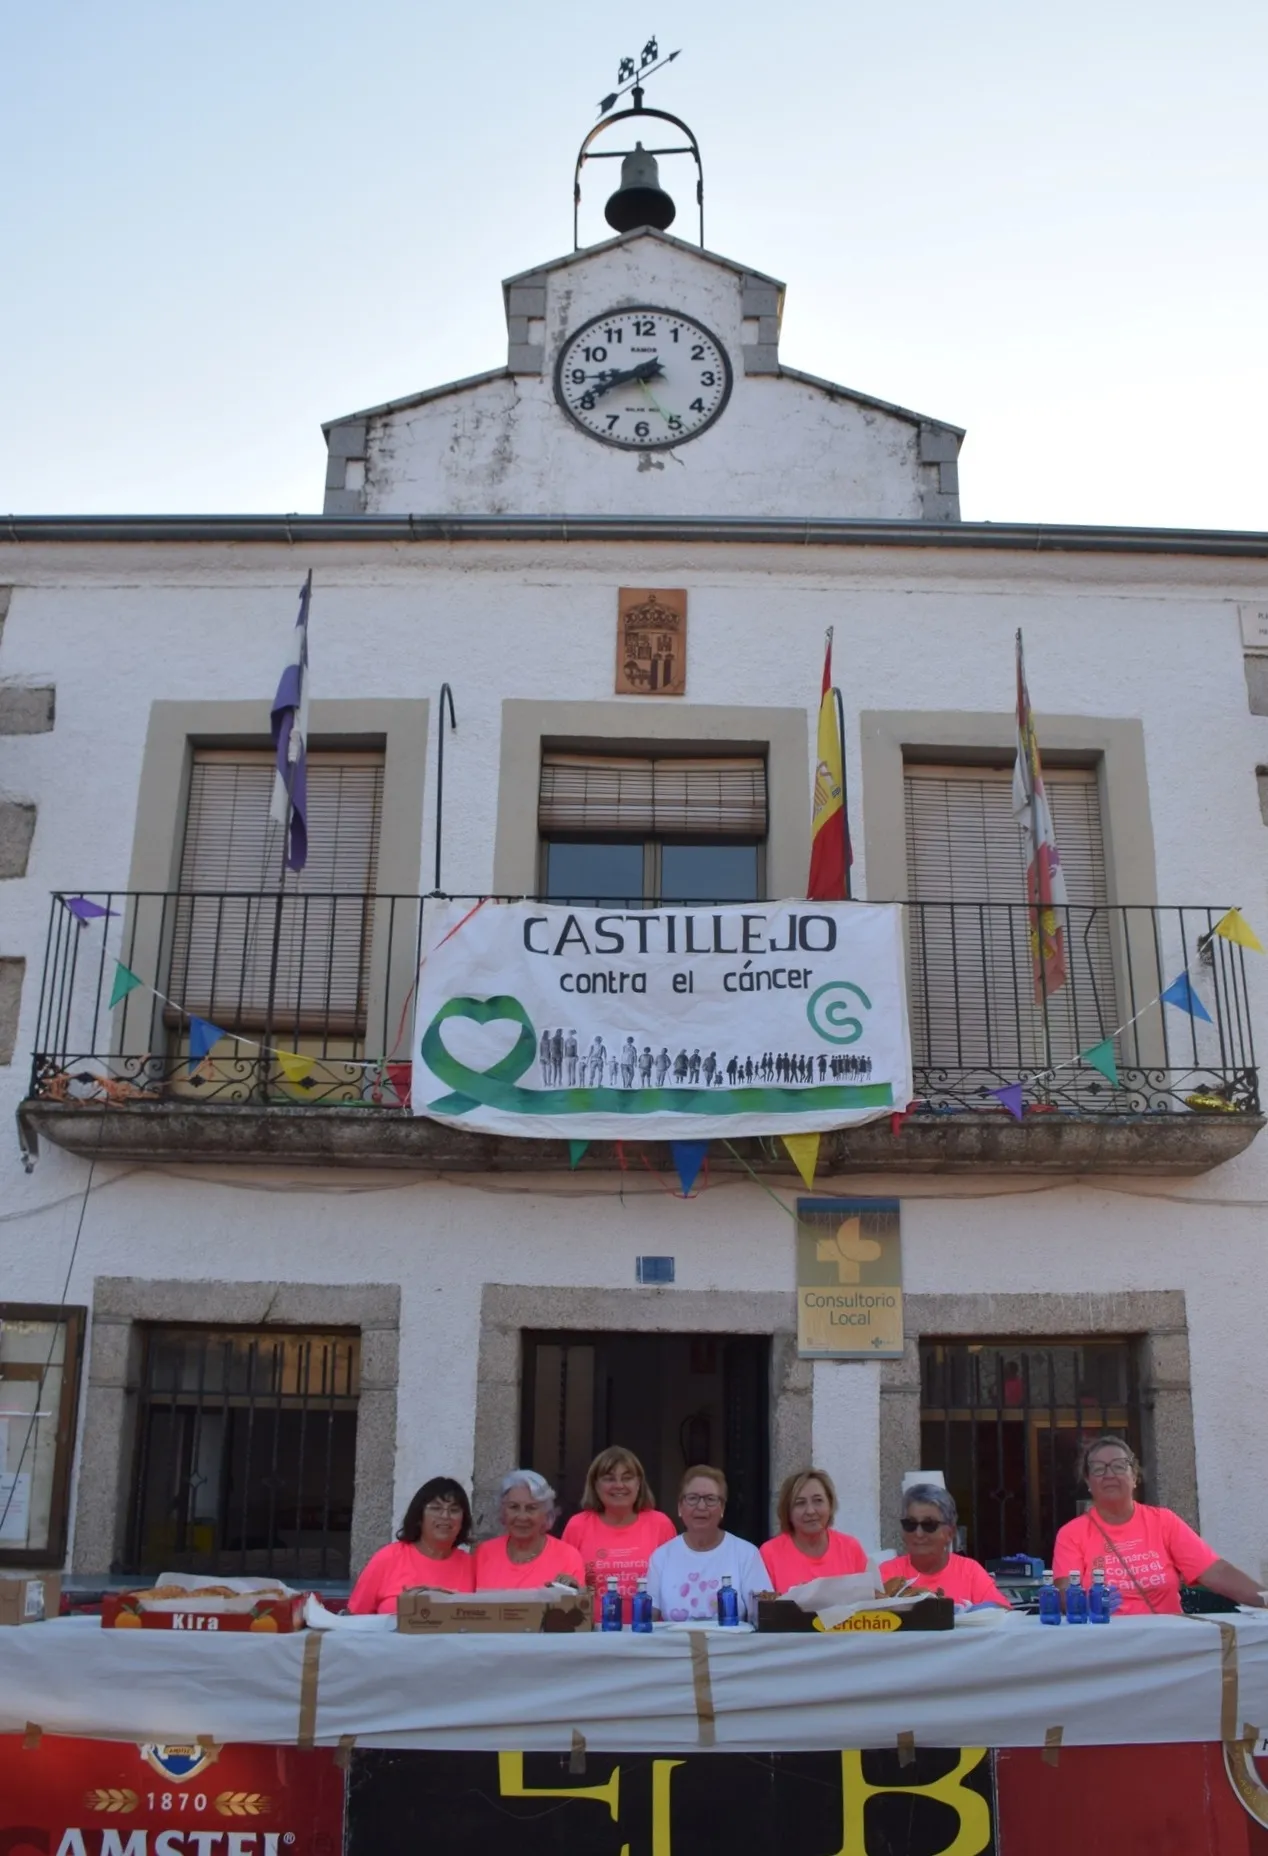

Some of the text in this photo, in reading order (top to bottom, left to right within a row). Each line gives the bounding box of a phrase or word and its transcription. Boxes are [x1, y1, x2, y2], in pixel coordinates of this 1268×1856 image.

[604, 328, 622, 343] 11
[632, 321, 656, 336] 12
[670, 328, 679, 343] 1
[581, 347, 607, 362] 10
[691, 345, 705, 361] 2
[571, 368, 586, 385] 9
[700, 371, 715, 387] 3
[689, 397, 705, 413] 4
[606, 415, 620, 430] 7
[634, 421, 650, 437] 6
[668, 415, 682, 431] 5
[523, 914, 837, 956] CASTILLEJO
[559, 959, 813, 994] contra el cáncer
[804, 1292, 896, 1308] Consultorio
[829, 1309, 871, 1326] Local
[613, 1559, 648, 1569] march
[172, 1613, 219, 1630] Kira
[147, 1792, 208, 1812] 1870
